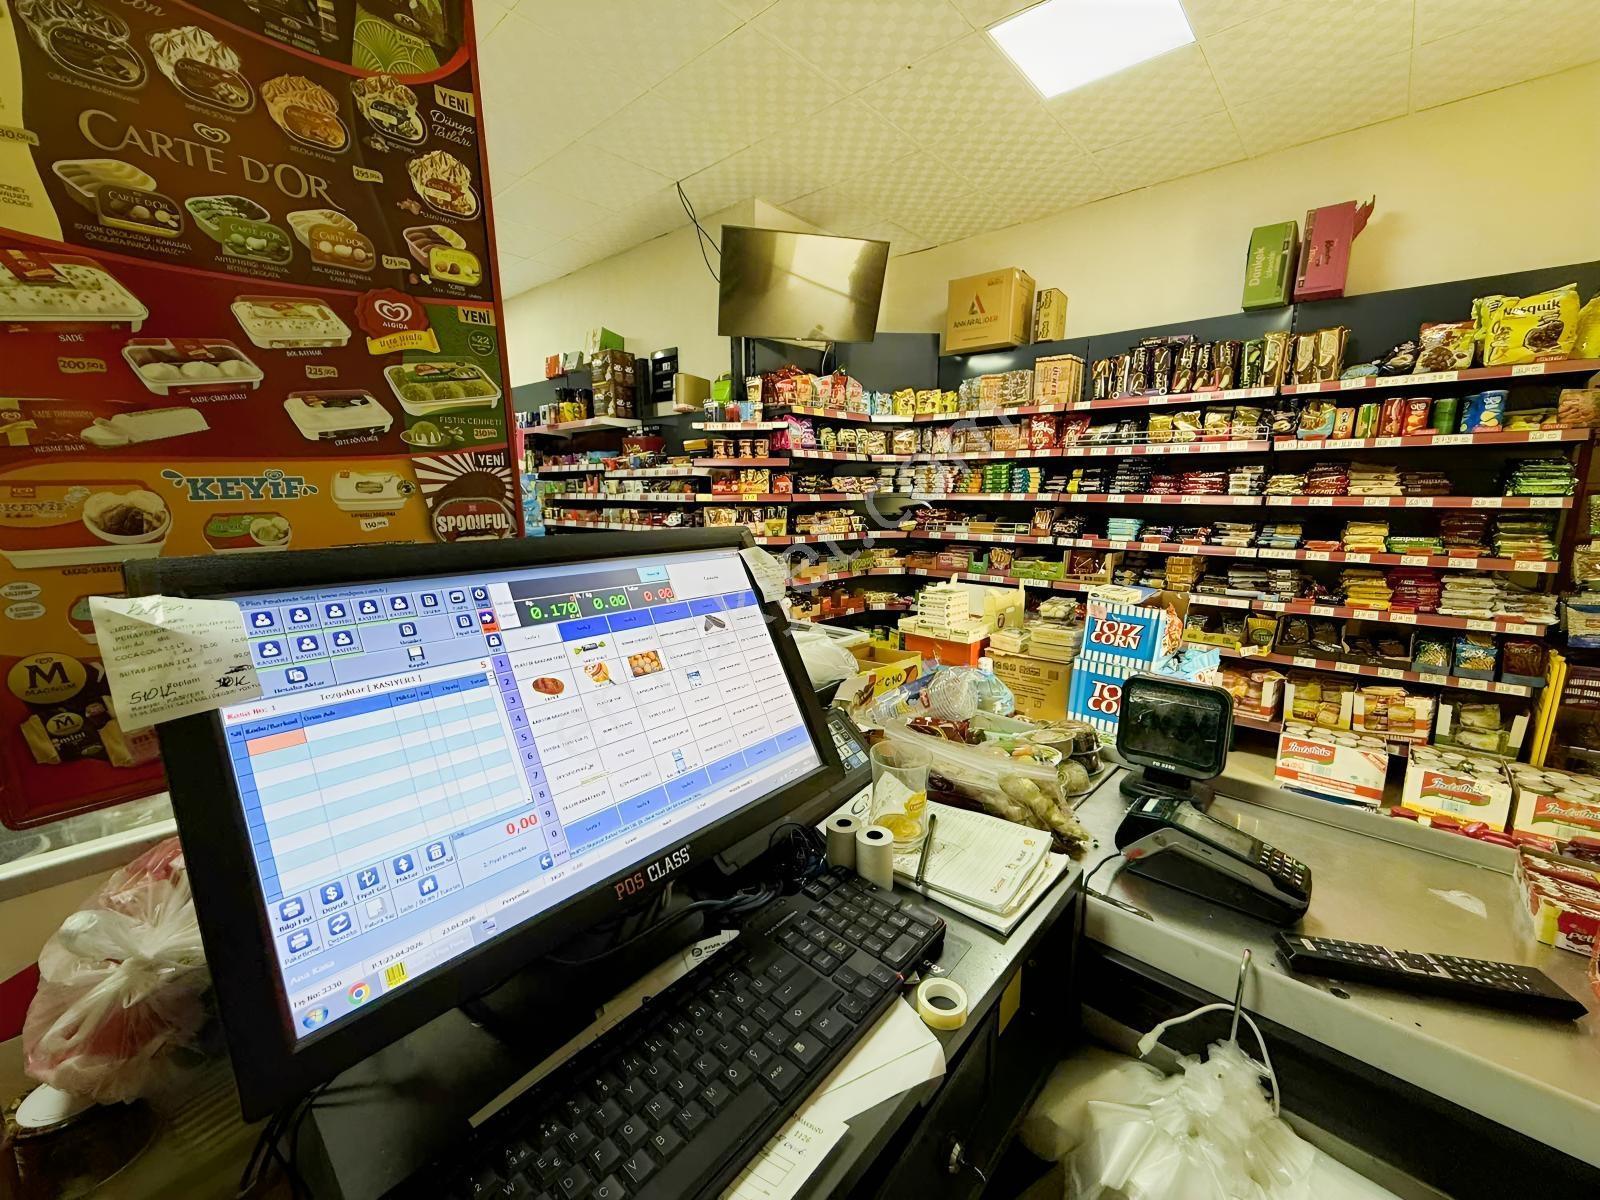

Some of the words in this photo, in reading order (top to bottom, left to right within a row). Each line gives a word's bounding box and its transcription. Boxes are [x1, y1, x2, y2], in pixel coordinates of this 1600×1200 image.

[439, 91, 469, 114] YENİ
[78, 109, 228, 175] CARTE
[238, 155, 346, 212] D'OR
[1503, 300, 1561, 316] Nesquik
[462, 310, 490, 324] YENİ
[382, 321, 408, 330] ALGIDA
[58, 334, 85, 342] SADE
[478, 453, 505, 467] YENİ
[436, 513, 510, 534] SPOONFUL
[593, 594, 627, 610] 0.00
[643, 587, 675, 602] 0.00
[530, 601, 579, 620] 0.170
[1092, 618, 1145, 639] TOPZ
[1090, 631, 1141, 650] CORN
[25, 681, 77, 697] MAGNUM
[1092, 680, 1122, 703] TO
[1087, 696, 1121, 717] CO
[506, 813, 539, 836] 0,00
[614, 872, 646, 901] POS
[646, 847, 690, 883] CLASS
[623, 1124, 634, 1135] G
[655, 1135, 665, 1146] B
[628, 1159, 637, 1170] V
[563, 1177, 574, 1188] D
